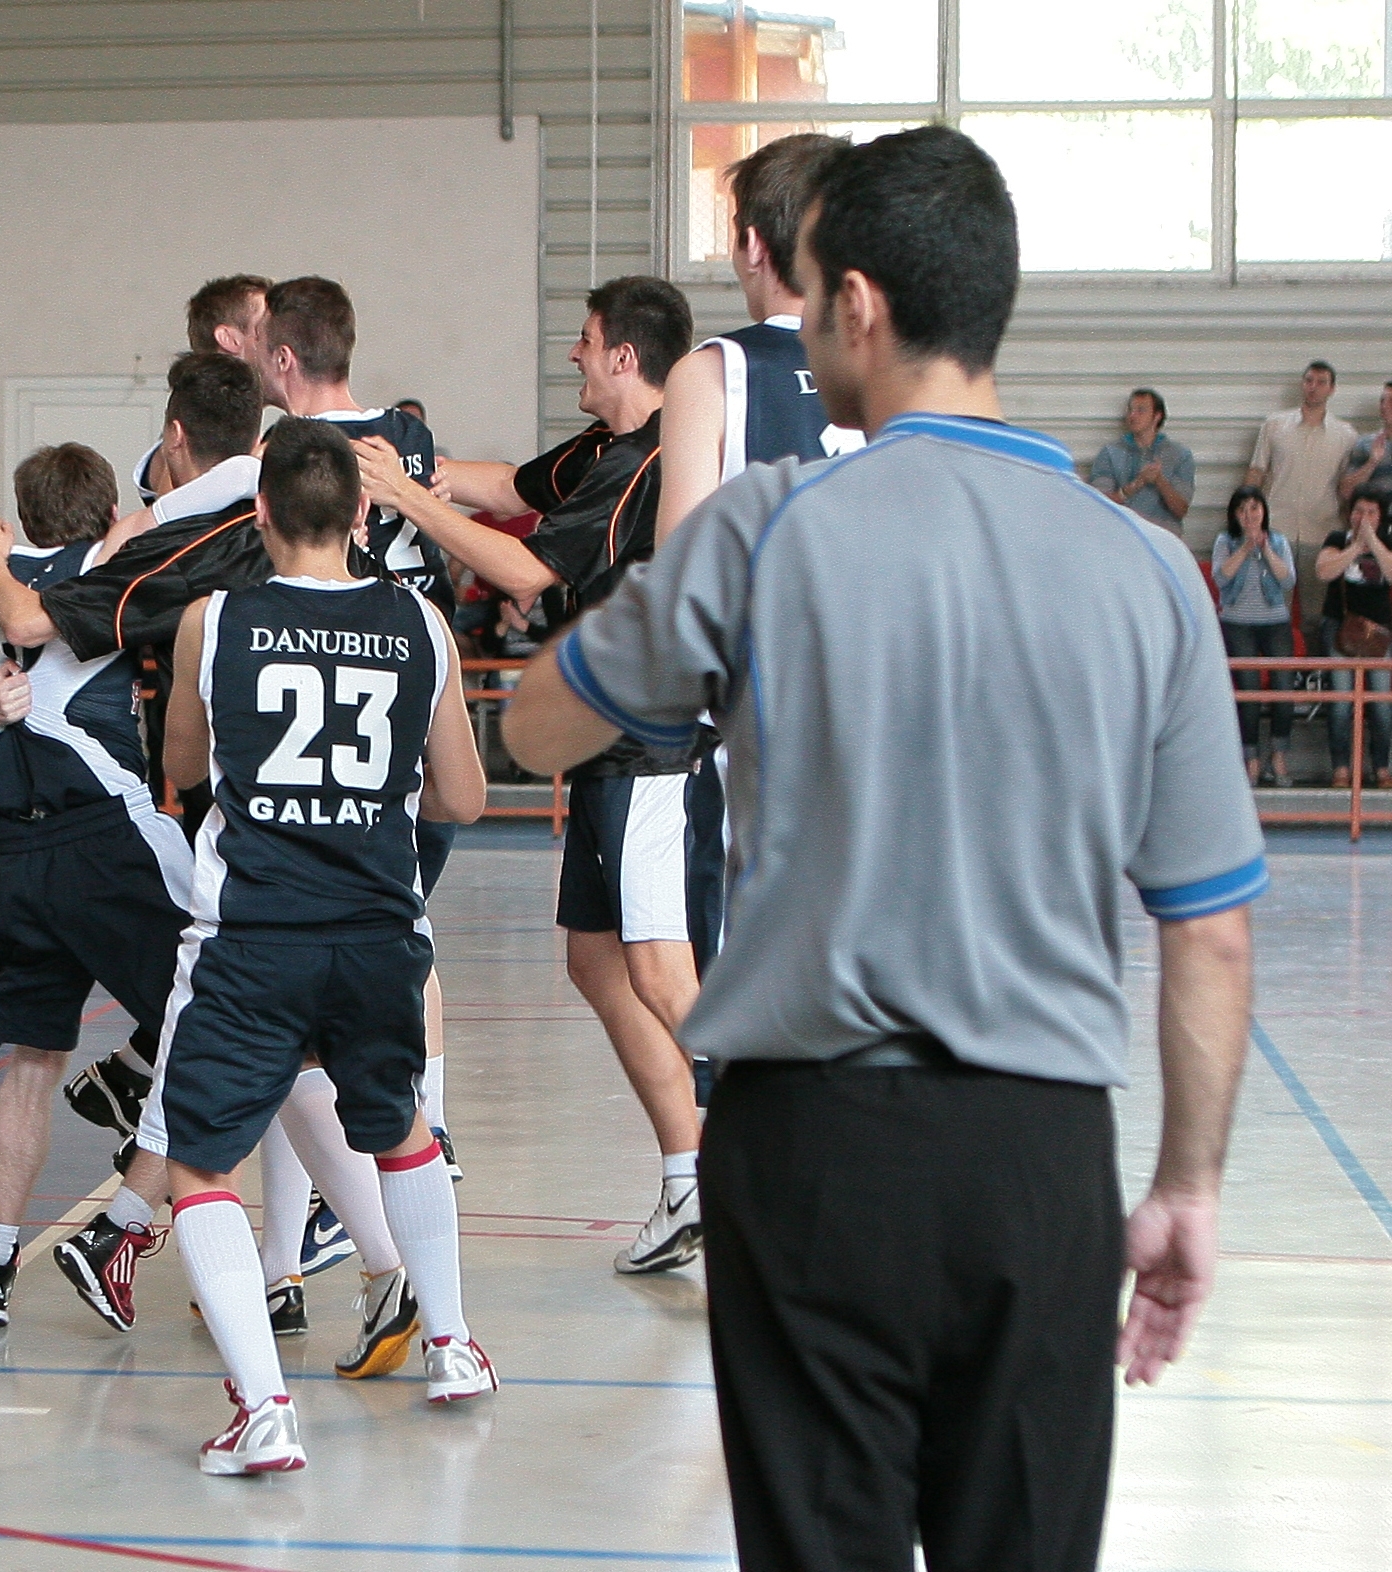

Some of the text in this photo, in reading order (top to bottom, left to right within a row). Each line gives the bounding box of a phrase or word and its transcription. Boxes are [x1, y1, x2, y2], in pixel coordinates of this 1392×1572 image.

[249, 627, 410, 662] DANUBIUS
[255, 662, 399, 791] 23
[248, 796, 383, 828] GALAT
